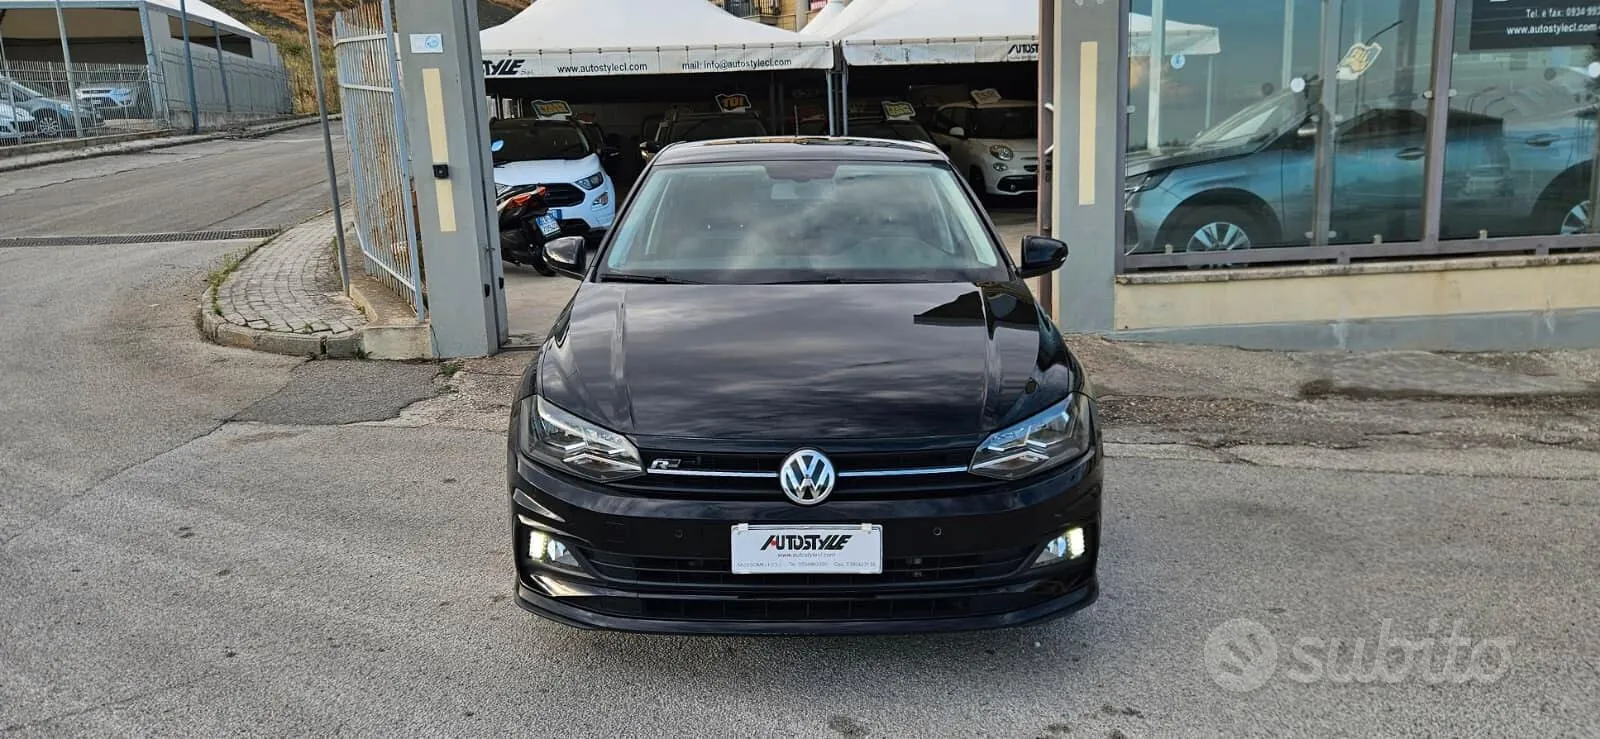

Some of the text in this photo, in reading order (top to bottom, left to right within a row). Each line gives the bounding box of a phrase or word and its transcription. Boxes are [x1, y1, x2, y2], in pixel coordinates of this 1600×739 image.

[1542, 9, 1547, 18] e
[1566, 6, 1586, 17] 0934
[1506, 23, 1597, 35] www.autostylecl.com
[1008, 44, 1039, 55] AUTOST
[482, 58, 526, 76] TYLE
[556, 62, 648, 74] www.autostylecl.com
[682, 57, 792, 71] mail: info@autostylecl.com
[760, 534, 853, 551] AUTOSTYLE
